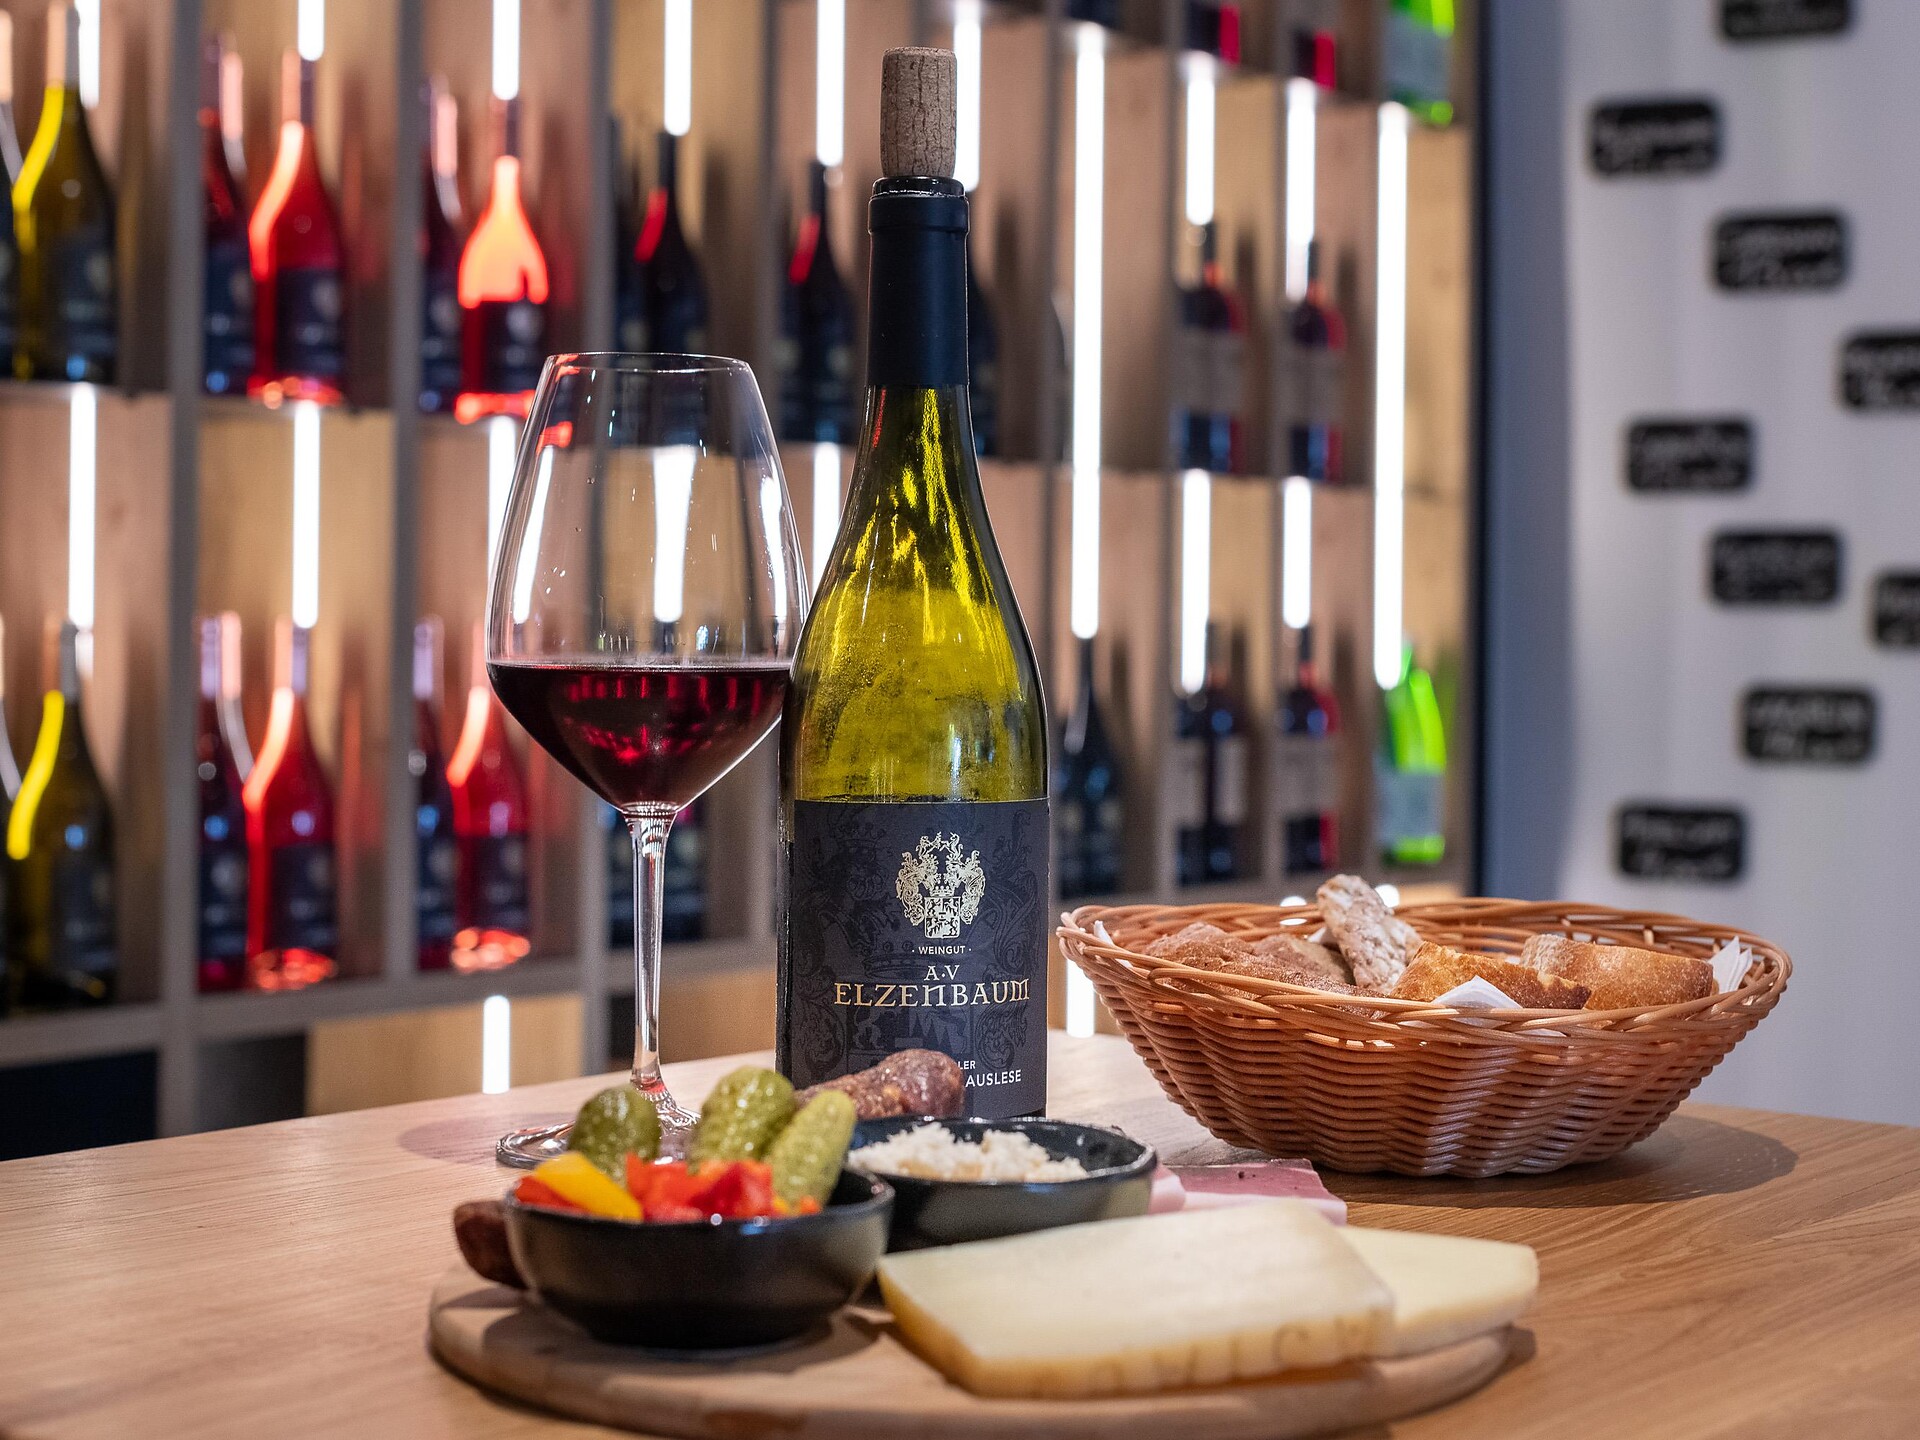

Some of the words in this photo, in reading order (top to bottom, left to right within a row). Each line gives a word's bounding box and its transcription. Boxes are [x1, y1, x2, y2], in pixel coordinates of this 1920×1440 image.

[918, 945, 966, 955] WEINGUT
[834, 978, 1030, 1007] ELZENBAUM
[957, 1060, 976, 1070] LER
[965, 1069, 1022, 1088] AUSLESE
